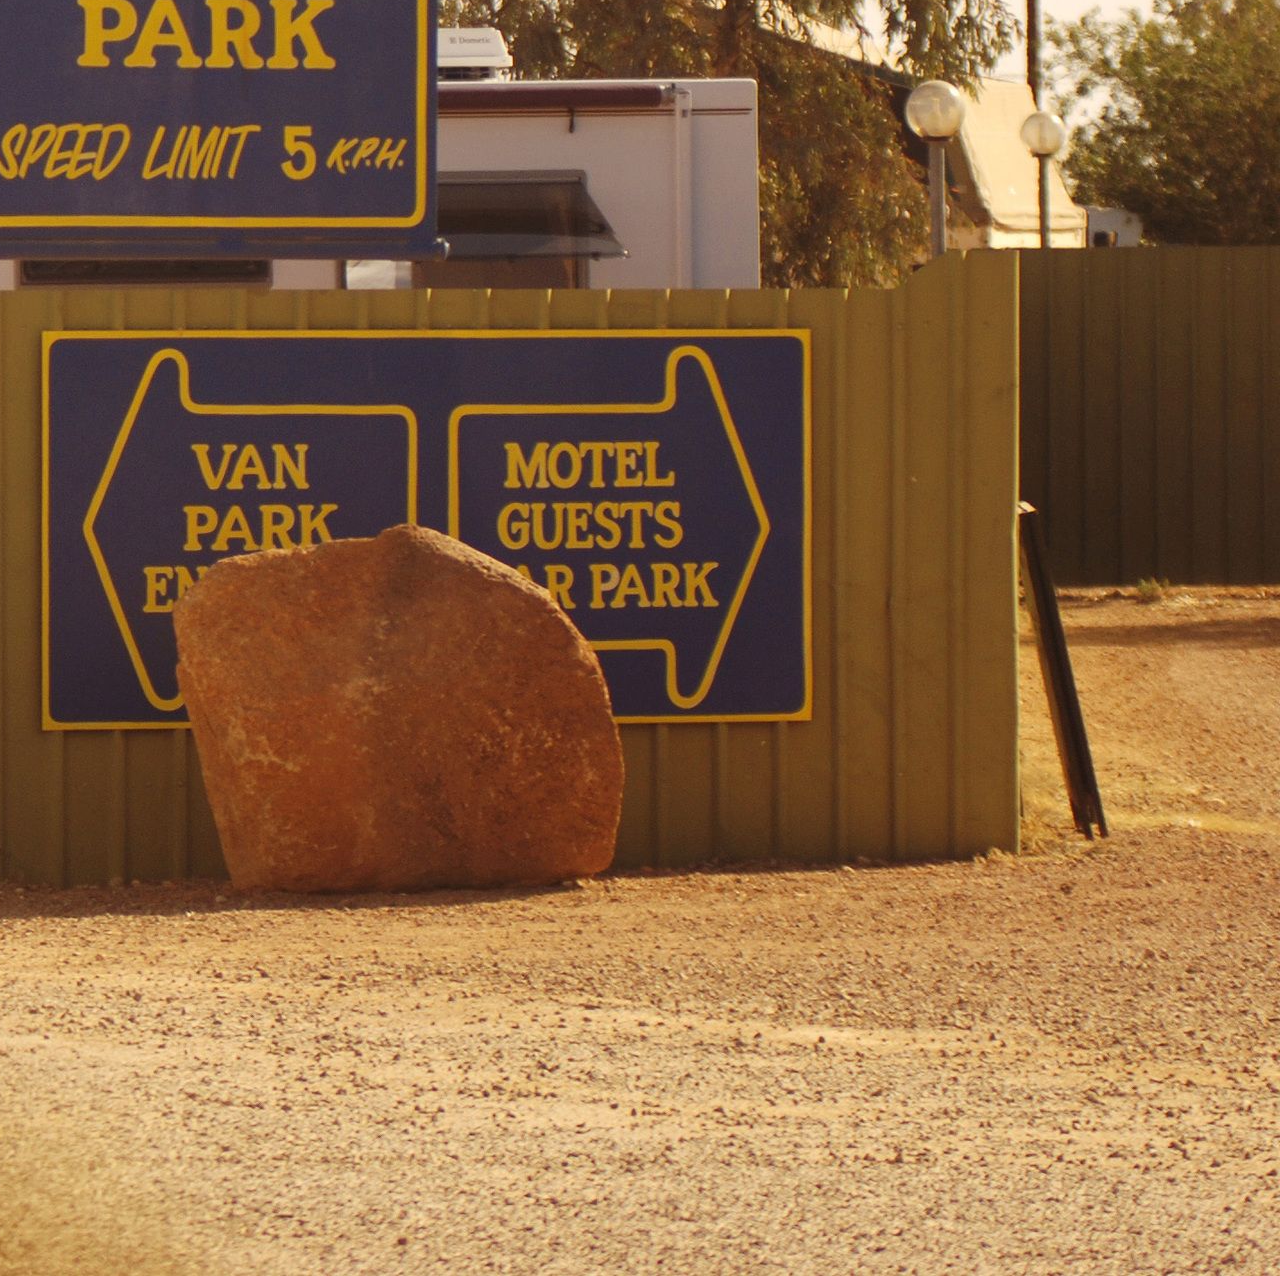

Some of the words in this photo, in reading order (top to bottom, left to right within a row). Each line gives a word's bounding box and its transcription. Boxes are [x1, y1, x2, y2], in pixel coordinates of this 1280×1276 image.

[142, 124, 262, 180] LIMIT
[282, 125, 317, 180] 5
[192, 443, 309, 490] VAN
[505, 441, 676, 489] MOTEL
[184, 503, 337, 551] PARK
[498, 500, 684, 550] GUESTS
[590, 561, 719, 609] PARK
